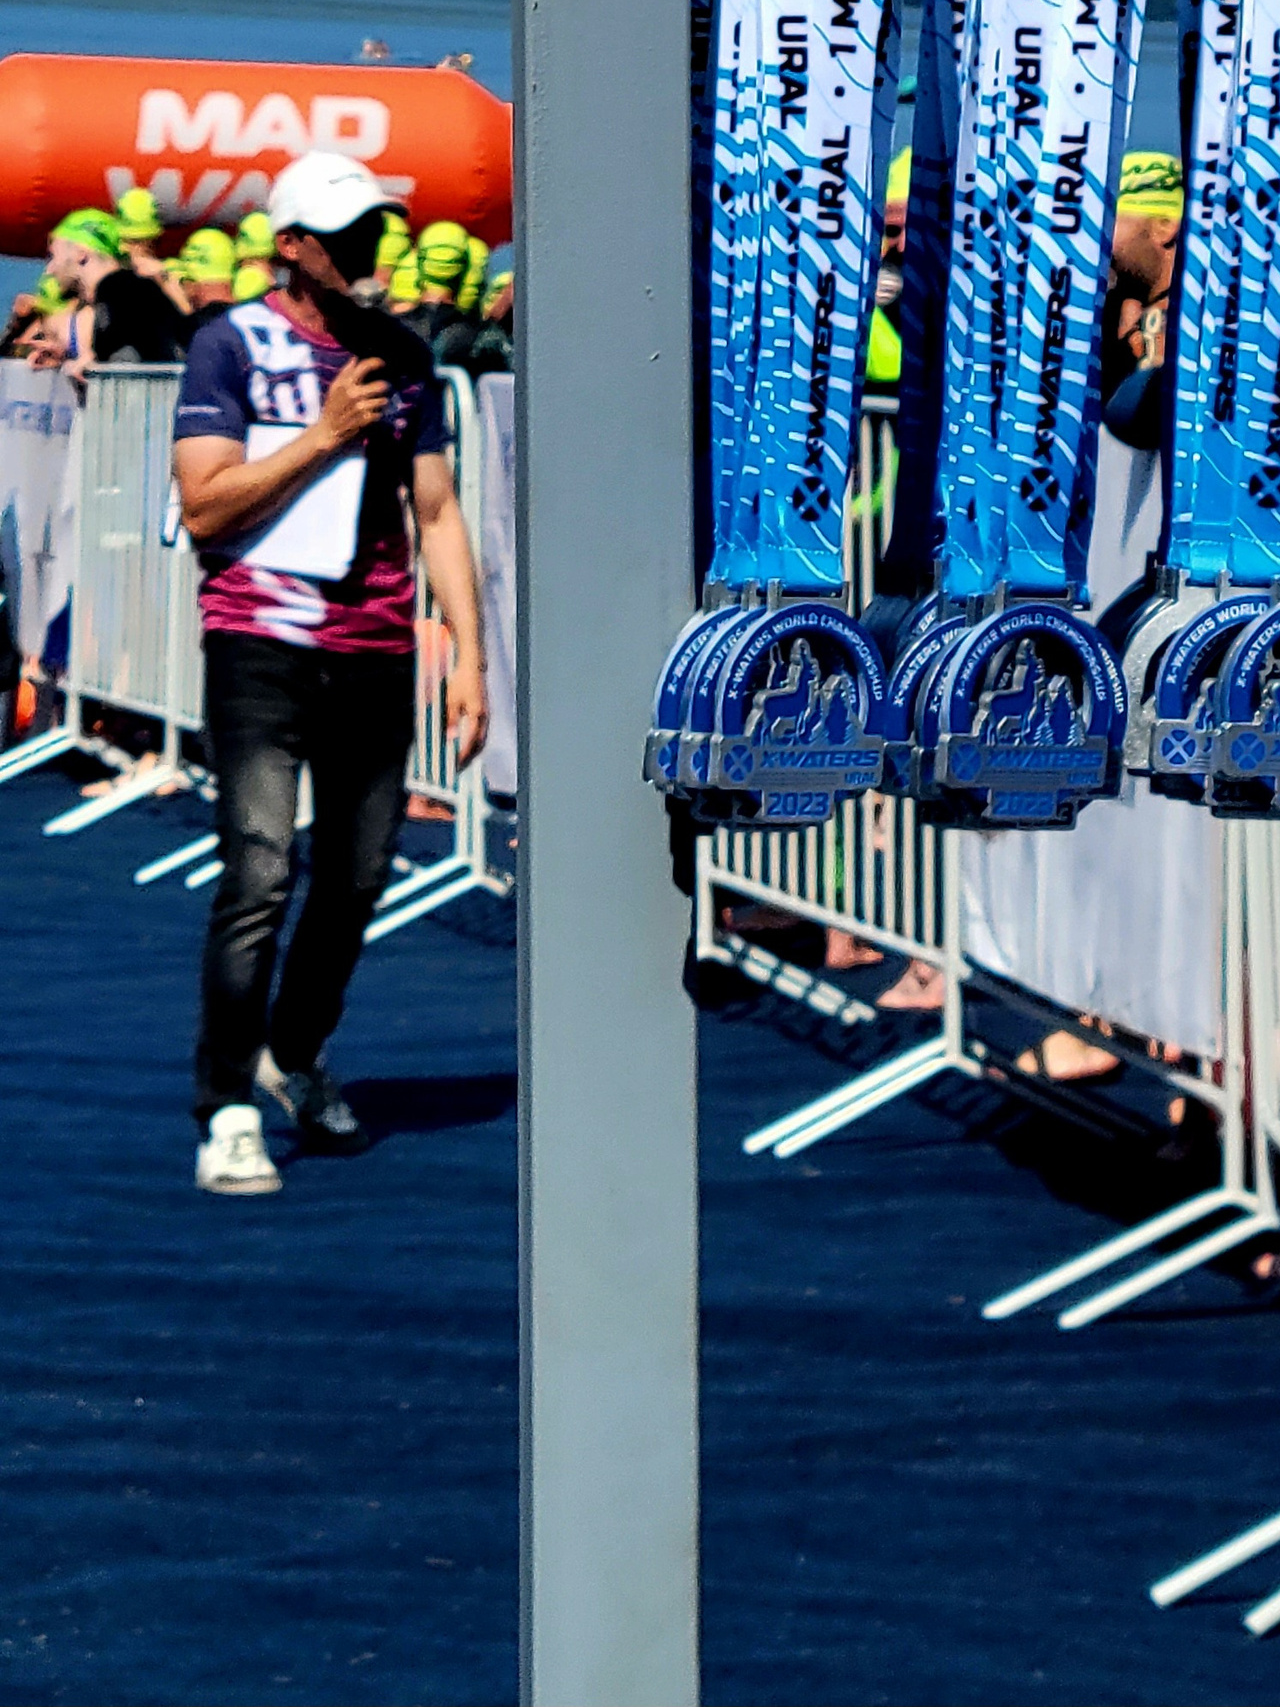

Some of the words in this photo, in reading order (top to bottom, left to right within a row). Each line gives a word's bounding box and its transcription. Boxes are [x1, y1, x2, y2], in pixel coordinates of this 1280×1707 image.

[778, 15, 808, 129] URAL
[830, 44, 856, 57] 1
[1014, 28, 1042, 140] URAL
[136, 89, 391, 161] MAD
[1052, 122, 1090, 234] URAL
[1072, 41, 1097, 55] 1
[104, 167, 416, 228] WA
[817, 126, 850, 240] URAL
[728, 631, 771, 700] X-WATERS
[773, 612, 818, 634] WORLD
[1000, 613, 1044, 633] WORLD
[1166, 618, 1215, 685] X-WATERS
[1216, 603, 1268, 621] WORLD
[767, 792, 829, 816] 2023
